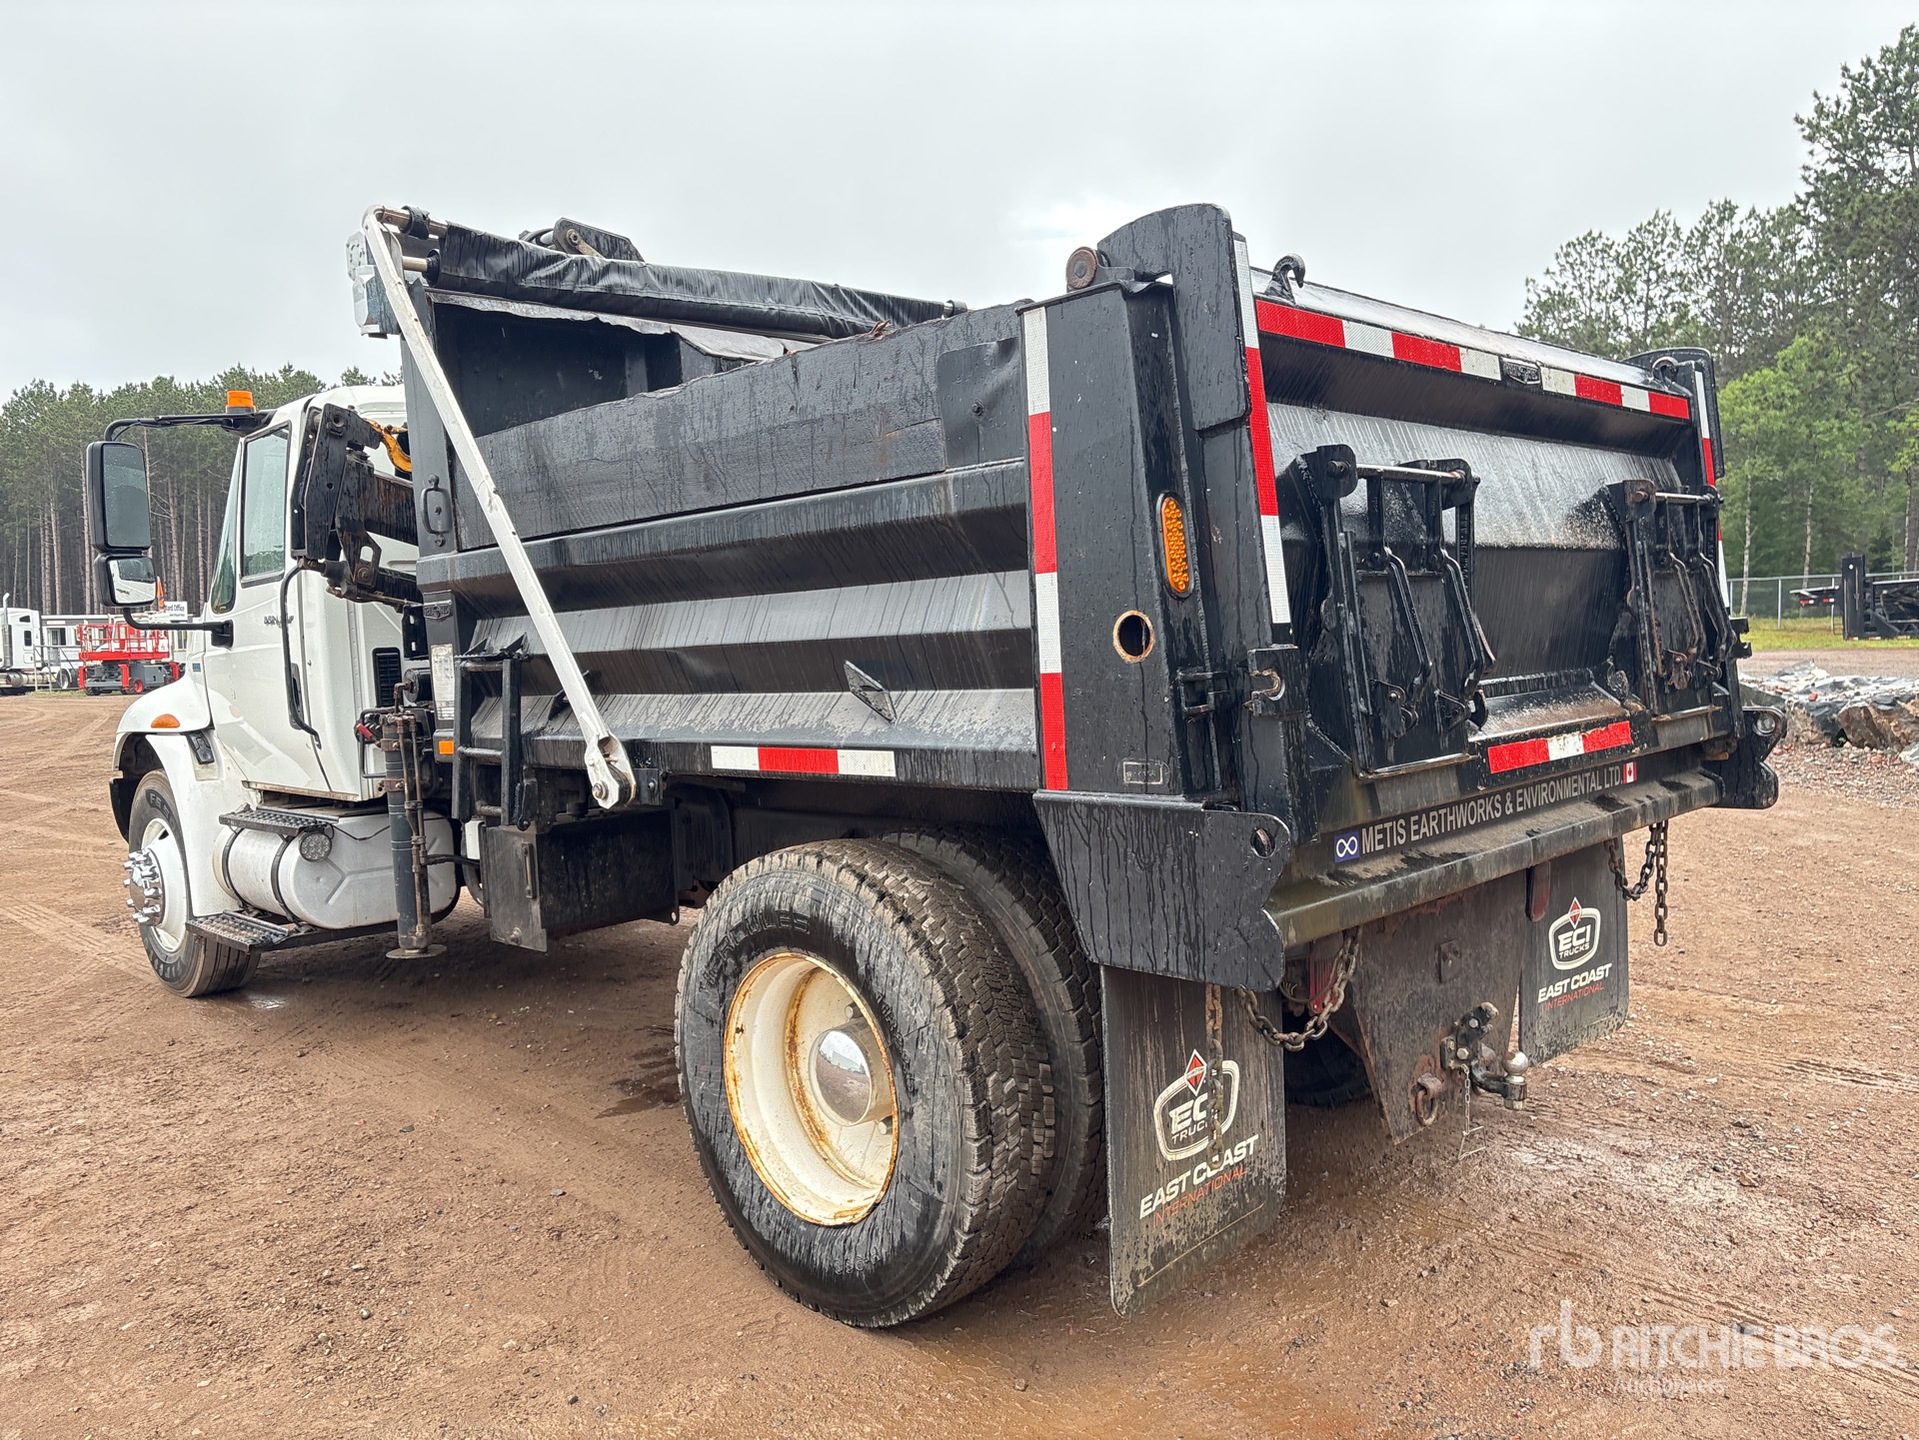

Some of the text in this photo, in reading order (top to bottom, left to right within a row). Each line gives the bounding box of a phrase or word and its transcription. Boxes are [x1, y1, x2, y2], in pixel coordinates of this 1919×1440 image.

[1362, 766, 1623, 855] METIS EARTHWORKS & ENVIRONMENTAL LTD.
[1558, 925, 1591, 951] ECI
[1559, 943, 1590, 959] TRUCKS
[1538, 963, 1612, 1003] EAST COAST
[1545, 982, 1605, 1010] INTERNATIONAL
[1140, 1171, 1190, 1219] EAST
[1153, 1165, 1247, 1229] INTERNATIONAL
